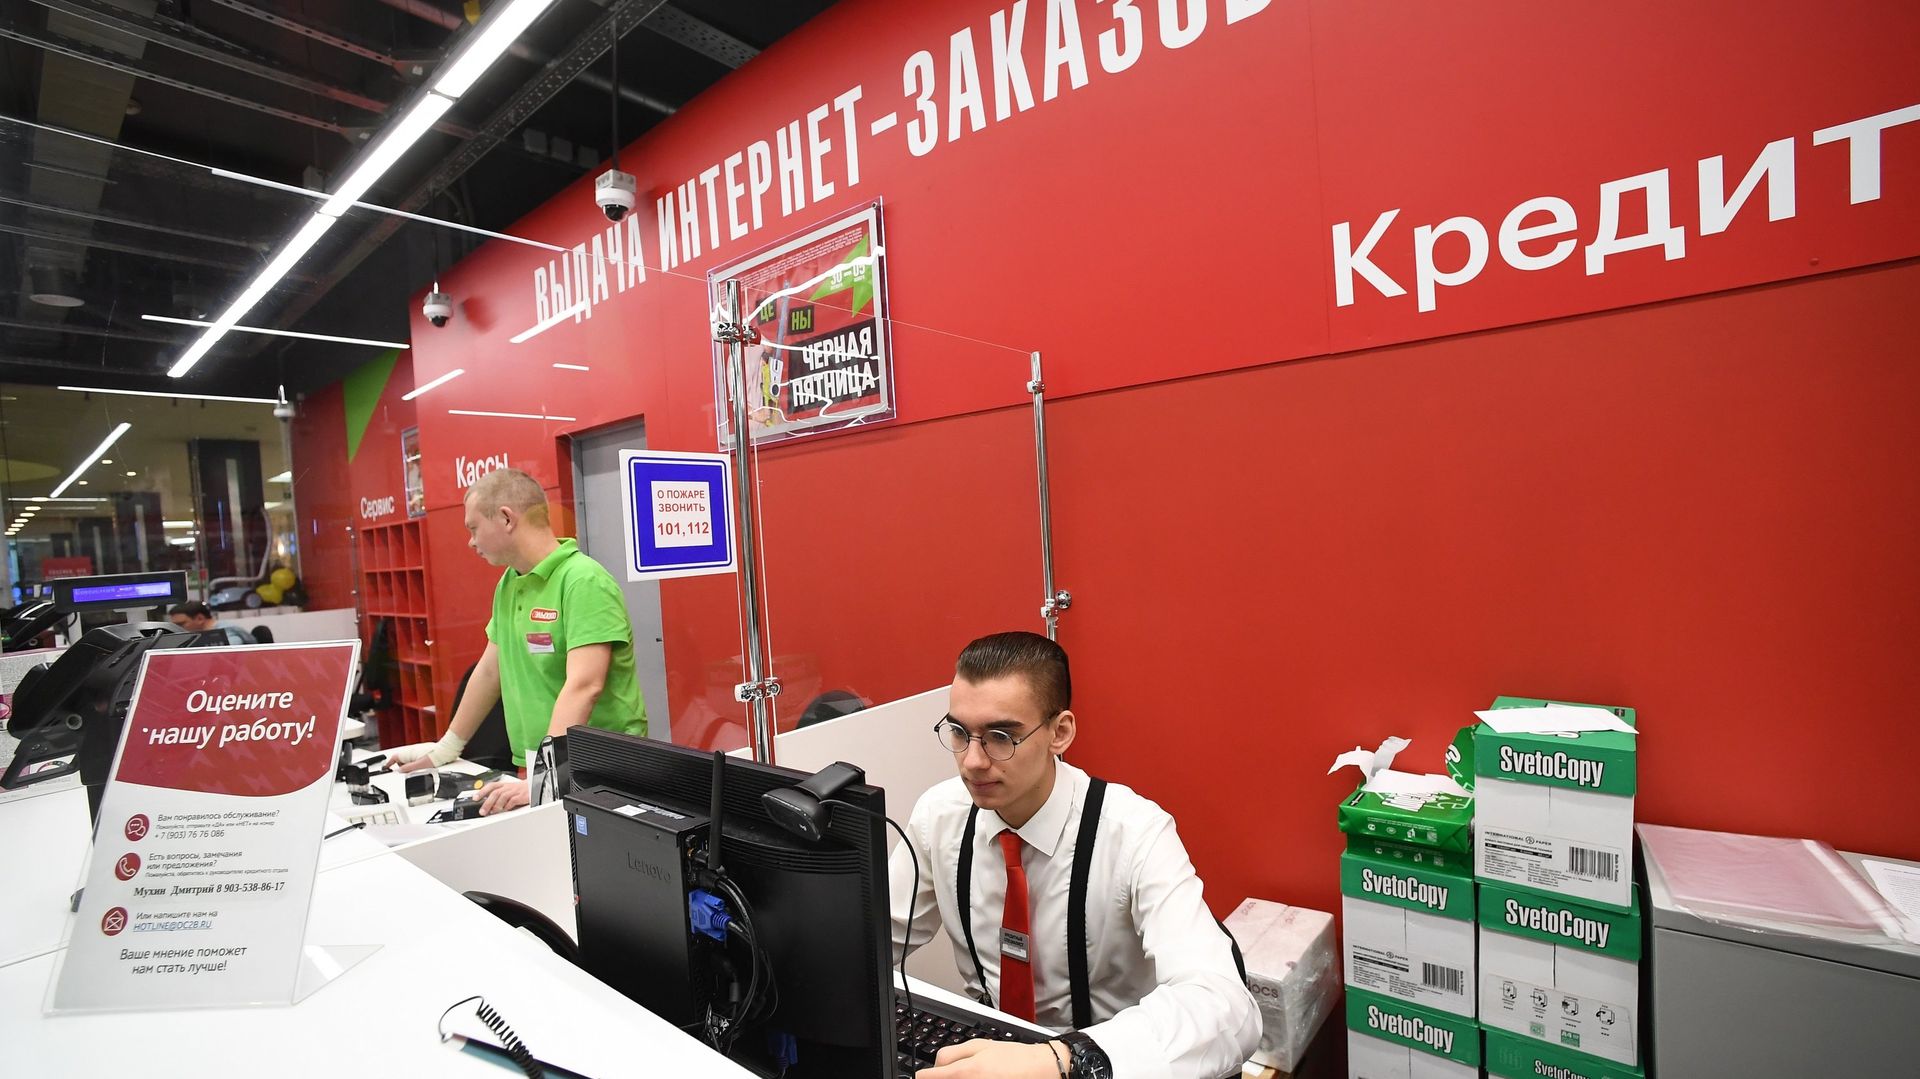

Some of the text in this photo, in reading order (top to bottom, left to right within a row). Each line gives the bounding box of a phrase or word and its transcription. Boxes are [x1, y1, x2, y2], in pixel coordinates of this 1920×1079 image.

[1332, 103, 1920, 313] Кредит
[534, 212, 646, 325] ВЫДАЧА
[791, 308, 812, 331] НЫ
[802, 326, 872, 371] ЧЕРНАЯ
[792, 361, 875, 407] ПЯТНИЦА
[657, 489, 705, 499] О ПОЖАРЕ
[361, 496, 395, 521] Сервис
[658, 503, 706, 513] ЗВОНИТЬ
[186, 690, 294, 715] Оцените
[149, 715, 316, 749] нашу работу!
[1500, 745, 1604, 788] SvetoCopy
[157, 810, 280, 823] Вам понравилось обслуживание?
[188, 831, 198, 839] 76
[199, 830, 209, 838] 76
[148, 851, 243, 862] Есть вопросы, замечания
[161, 860, 218, 870] предложения?
[627, 850, 671, 881] Lenovo
[133, 882, 286, 898] Мухин Дмитрий 8 903-538-86-17
[1362, 868, 1448, 910] SvetoCopy
[136, 912, 152, 920] Или
[153, 912, 192, 920] напишите
[1506, 899, 1609, 948] SvetoCopy
[120, 947, 247, 960] Ваше мнение поможет
[132, 960, 227, 975] нам стать лучше!
[1368, 1004, 1454, 1053] SvetoCopy
